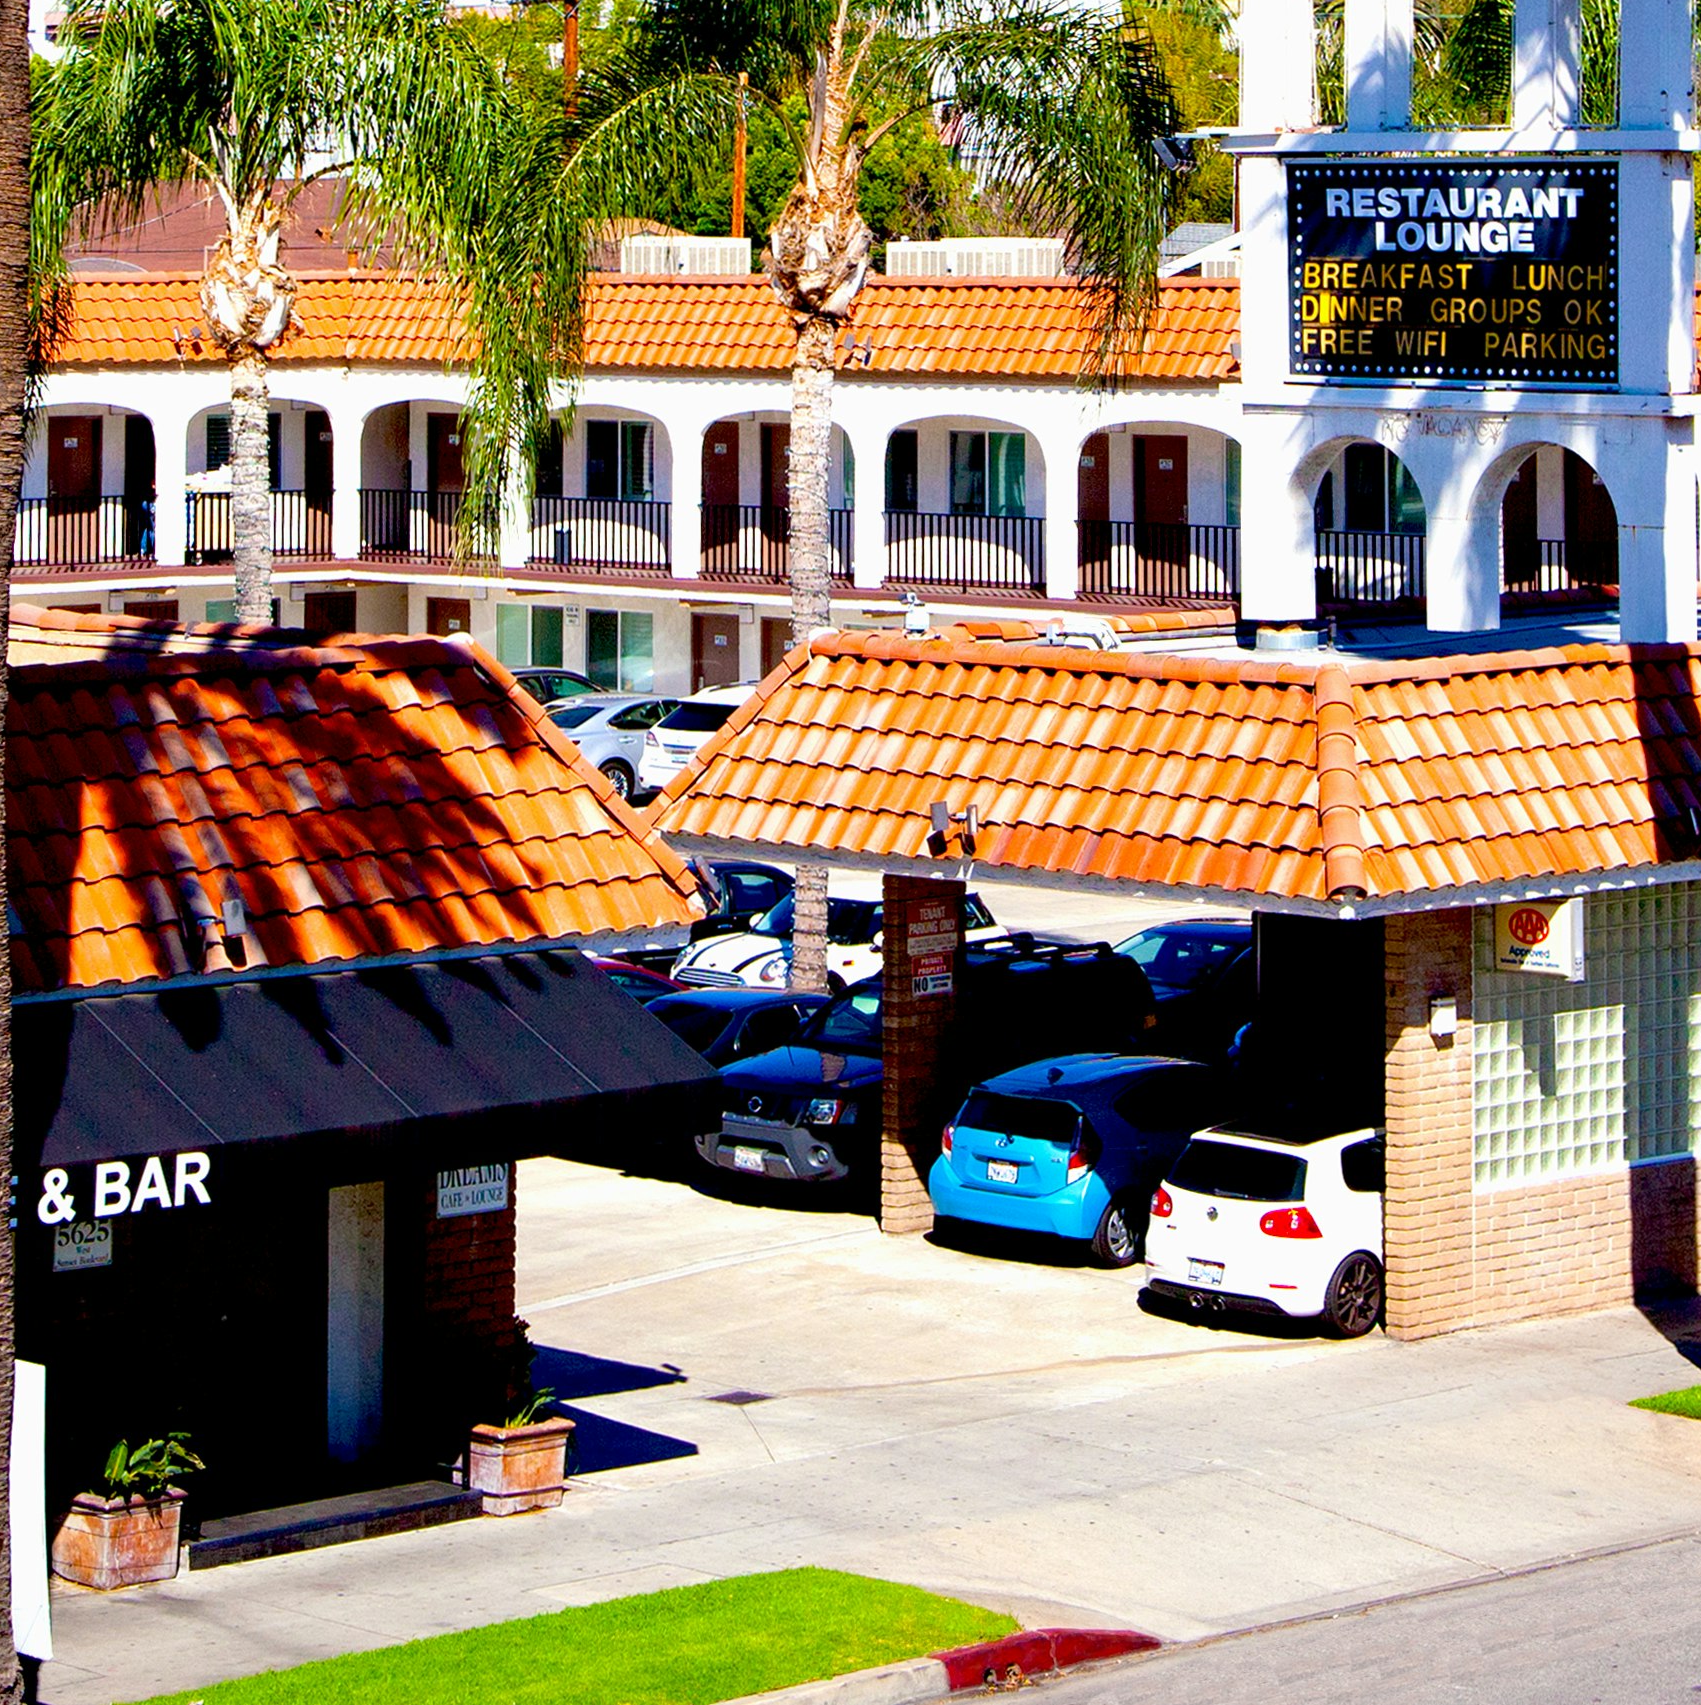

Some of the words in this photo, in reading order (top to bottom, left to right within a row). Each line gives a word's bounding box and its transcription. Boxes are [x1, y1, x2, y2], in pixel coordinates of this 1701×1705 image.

[1326, 188, 1584, 218] RESTAURANT
[1375, 221, 1535, 253] LOUNGE
[1304, 263, 1473, 290] BREAKFAST
[1513, 264, 1603, 291] LUNCH
[1302, 292, 1402, 323] DINNER
[1431, 298, 1541, 323] GROUPS
[1564, 299, 1602, 325] OK
[1302, 329, 1373, 355] FREE
[1396, 331, 1446, 356] WIFI
[1485, 332, 1605, 359] PARKING
[908, 921, 938, 935] PARKING
[1512, 910, 1547, 942] AAA
[1509, 946, 1550, 959] Approved
[914, 977, 928, 993] NO
[38, 1168, 75, 1225] &
[94, 1152, 211, 1217] BAR
[441, 1193, 462, 1209] CAFE
[472, 1187, 504, 1205] LOUNGE
[57, 1220, 109, 1246] 5625
